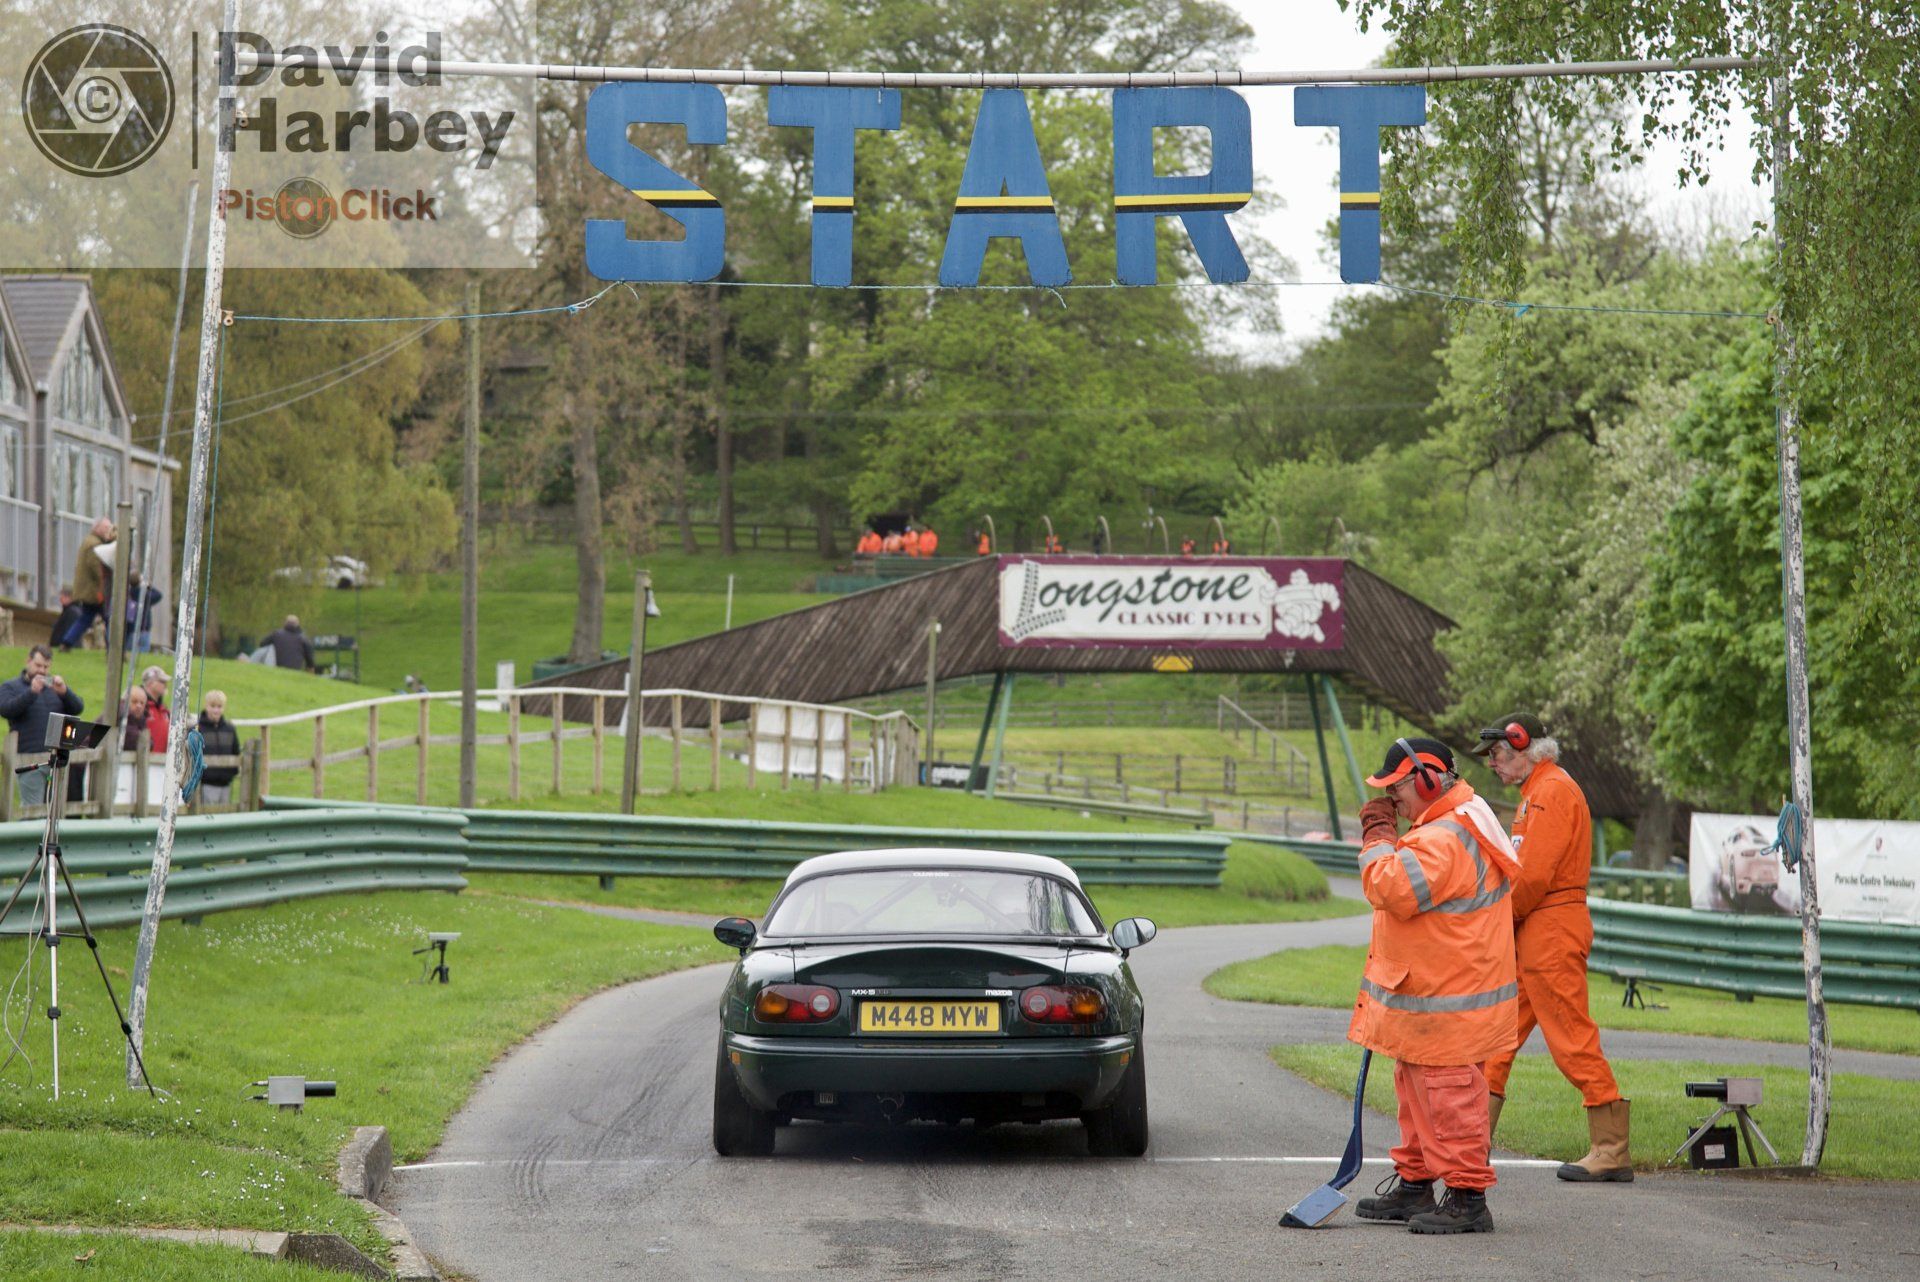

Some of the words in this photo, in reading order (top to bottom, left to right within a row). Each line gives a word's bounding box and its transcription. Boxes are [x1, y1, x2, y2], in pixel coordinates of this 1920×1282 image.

[586, 81, 1427, 287] START
[1118, 610, 1197, 626] CLASSIC
[1203, 610, 1262, 626] TYRES
[1859, 873, 1881, 887] Centre
[871, 1005, 935, 1027] M448
[941, 1005, 988, 1027] MYW
